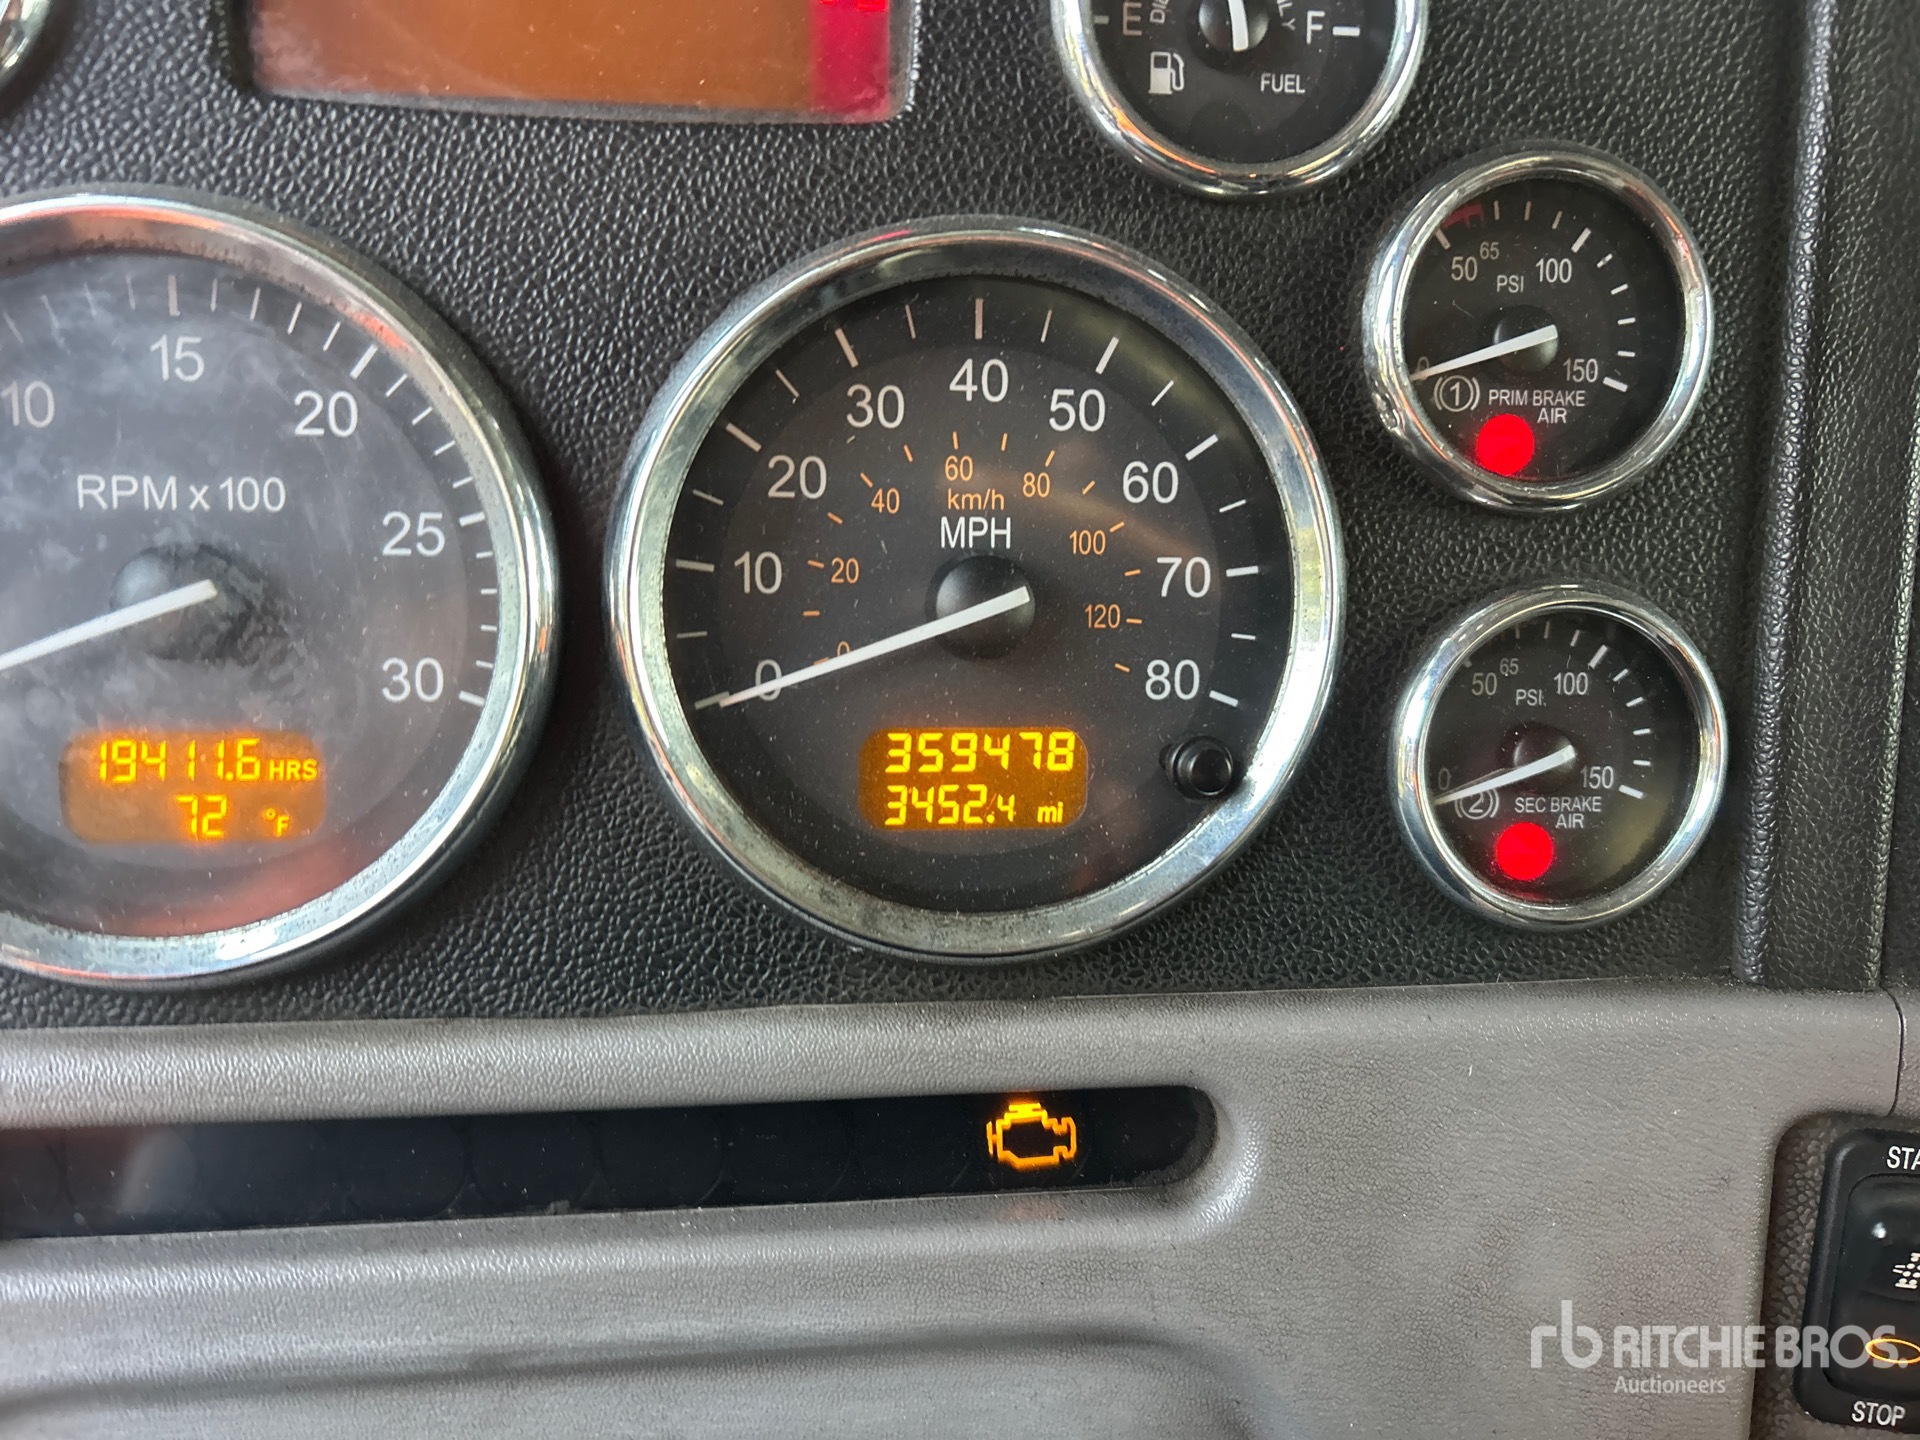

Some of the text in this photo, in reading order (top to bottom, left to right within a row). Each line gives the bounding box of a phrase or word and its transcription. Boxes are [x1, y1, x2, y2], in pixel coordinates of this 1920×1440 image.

[1122, 1, 1143, 36] E
[1305, 10, 1326, 44] F
[1260, 73, 1306, 94] FUEL
[1479, 241, 1500, 260] 65
[1451, 256, 1478, 282] 50
[1535, 257, 1573, 284] 100
[1496, 274, 1525, 293] PSI
[149, 334, 206, 382] 15
[1562, 358, 1599, 383] 150
[949, 358, 1010, 403] 40
[0, 379, 56, 428] 10
[846, 384, 905, 429] 30
[1048, 388, 1107, 432] 50
[1488, 388, 1586, 407] PRIM BRAKE
[294, 389, 359, 437] 20
[1536, 406, 1568, 425] AIR
[766, 455, 828, 499] 20
[944, 455, 974, 482] 60
[1122, 460, 1179, 504] 60
[76, 474, 178, 511] RPM
[218, 476, 287, 512] 100
[1022, 472, 1051, 498] 80
[871, 488, 900, 514] 40
[946, 488, 1006, 511] km/h
[382, 511, 446, 557] 25
[939, 516, 1012, 549] MPH
[1069, 529, 1106, 555] 100
[733, 551, 783, 594] 10
[831, 557, 860, 584] 20
[1156, 556, 1212, 598] 70
[1085, 603, 1121, 629] 120
[381, 657, 445, 703] 30
[755, 658, 782, 702] 0
[1144, 659, 1201, 701] 80
[1499, 657, 1519, 676] 65
[1471, 672, 1498, 696] 50
[1515, 688, 1543, 706] PSI
[1553, 671, 1589, 696] 100
[884, 730, 1077, 774] 359478
[268, 759, 319, 782] HRS
[1579, 765, 1615, 790] 150
[174, 794, 228, 840] 72
[884, 783, 1065, 827] 3452.4 mi
[1513, 795, 1602, 814] SEC BRAKE
[1554, 812, 1585, 830] AIR
[1851, 1400, 1906, 1427] STOP
